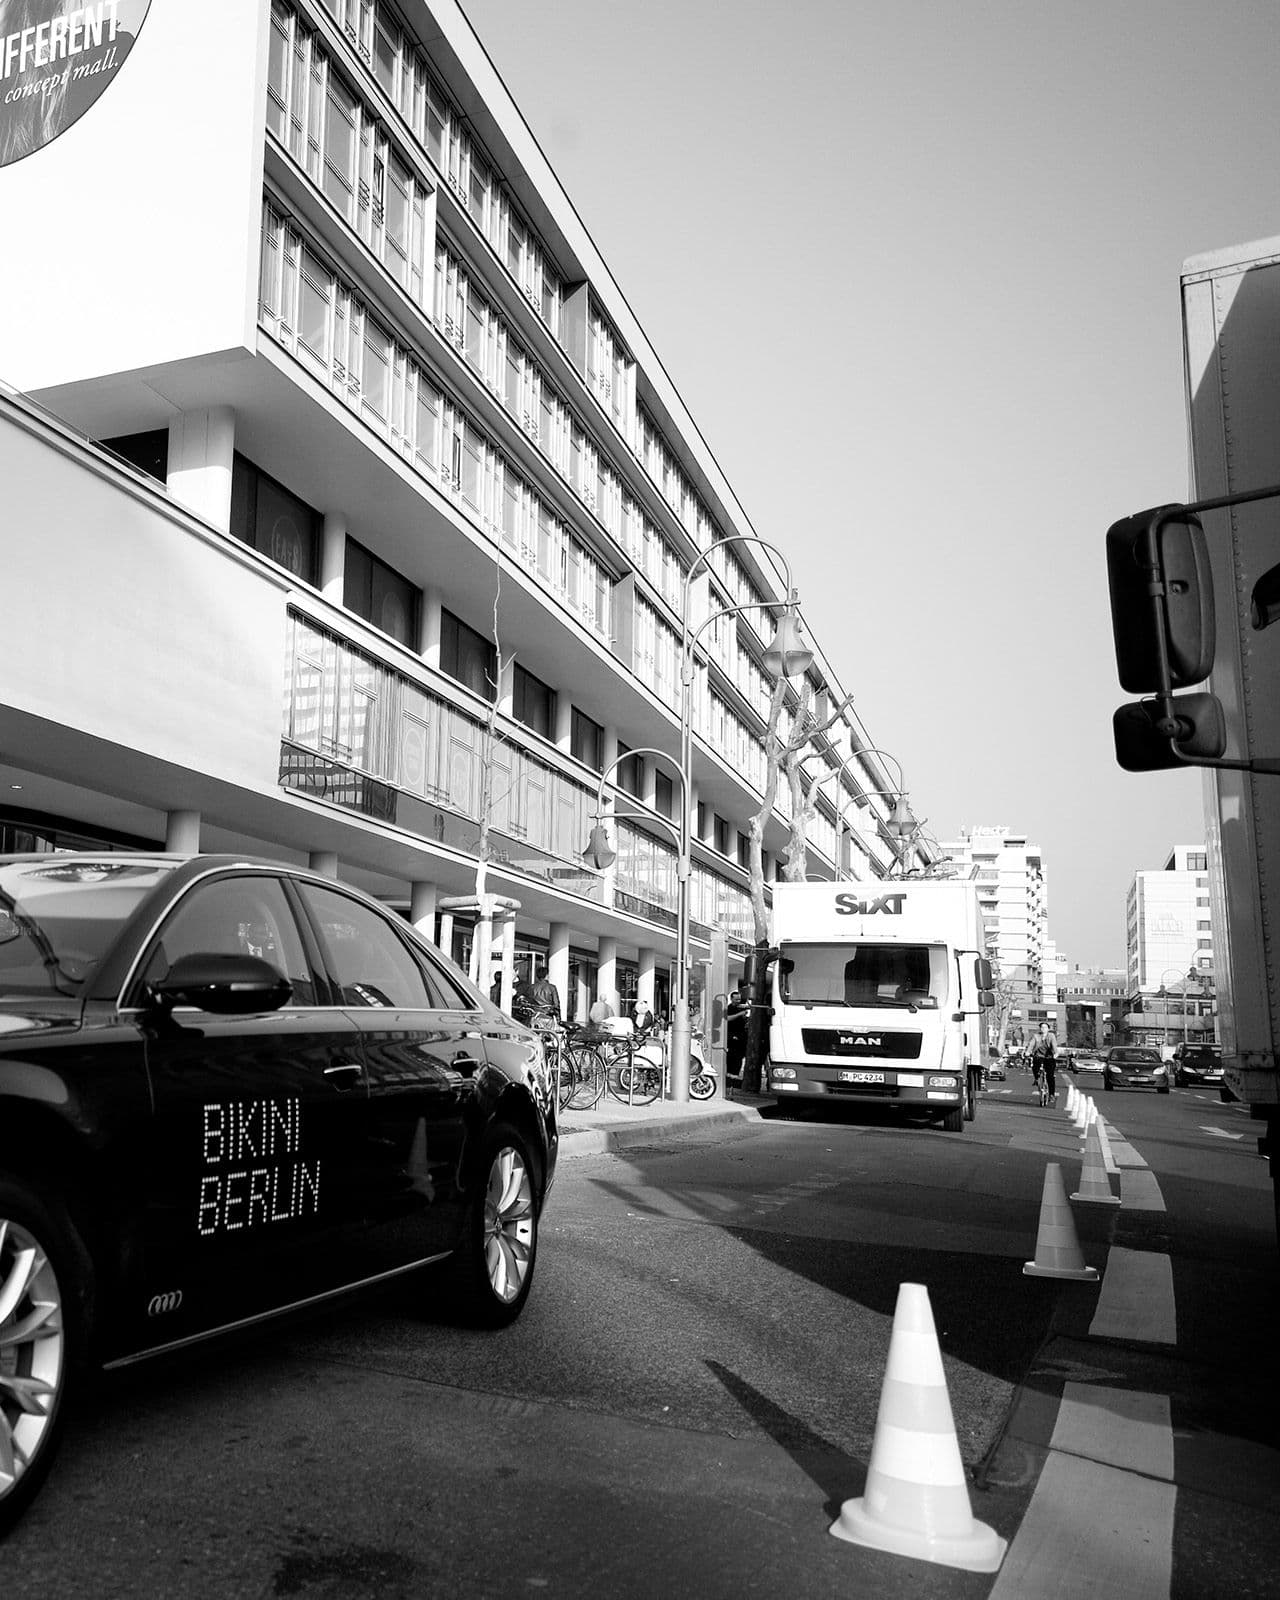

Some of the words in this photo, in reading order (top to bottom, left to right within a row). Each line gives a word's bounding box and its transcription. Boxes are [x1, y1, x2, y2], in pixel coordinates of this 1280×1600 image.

[4, 71, 69, 105] concept
[73, 46, 119, 81] mall.
[840, 1036, 881, 1046] MAN
[203, 1097, 300, 1164] BIKINI
[197, 1160, 321, 1236] BERLIN
